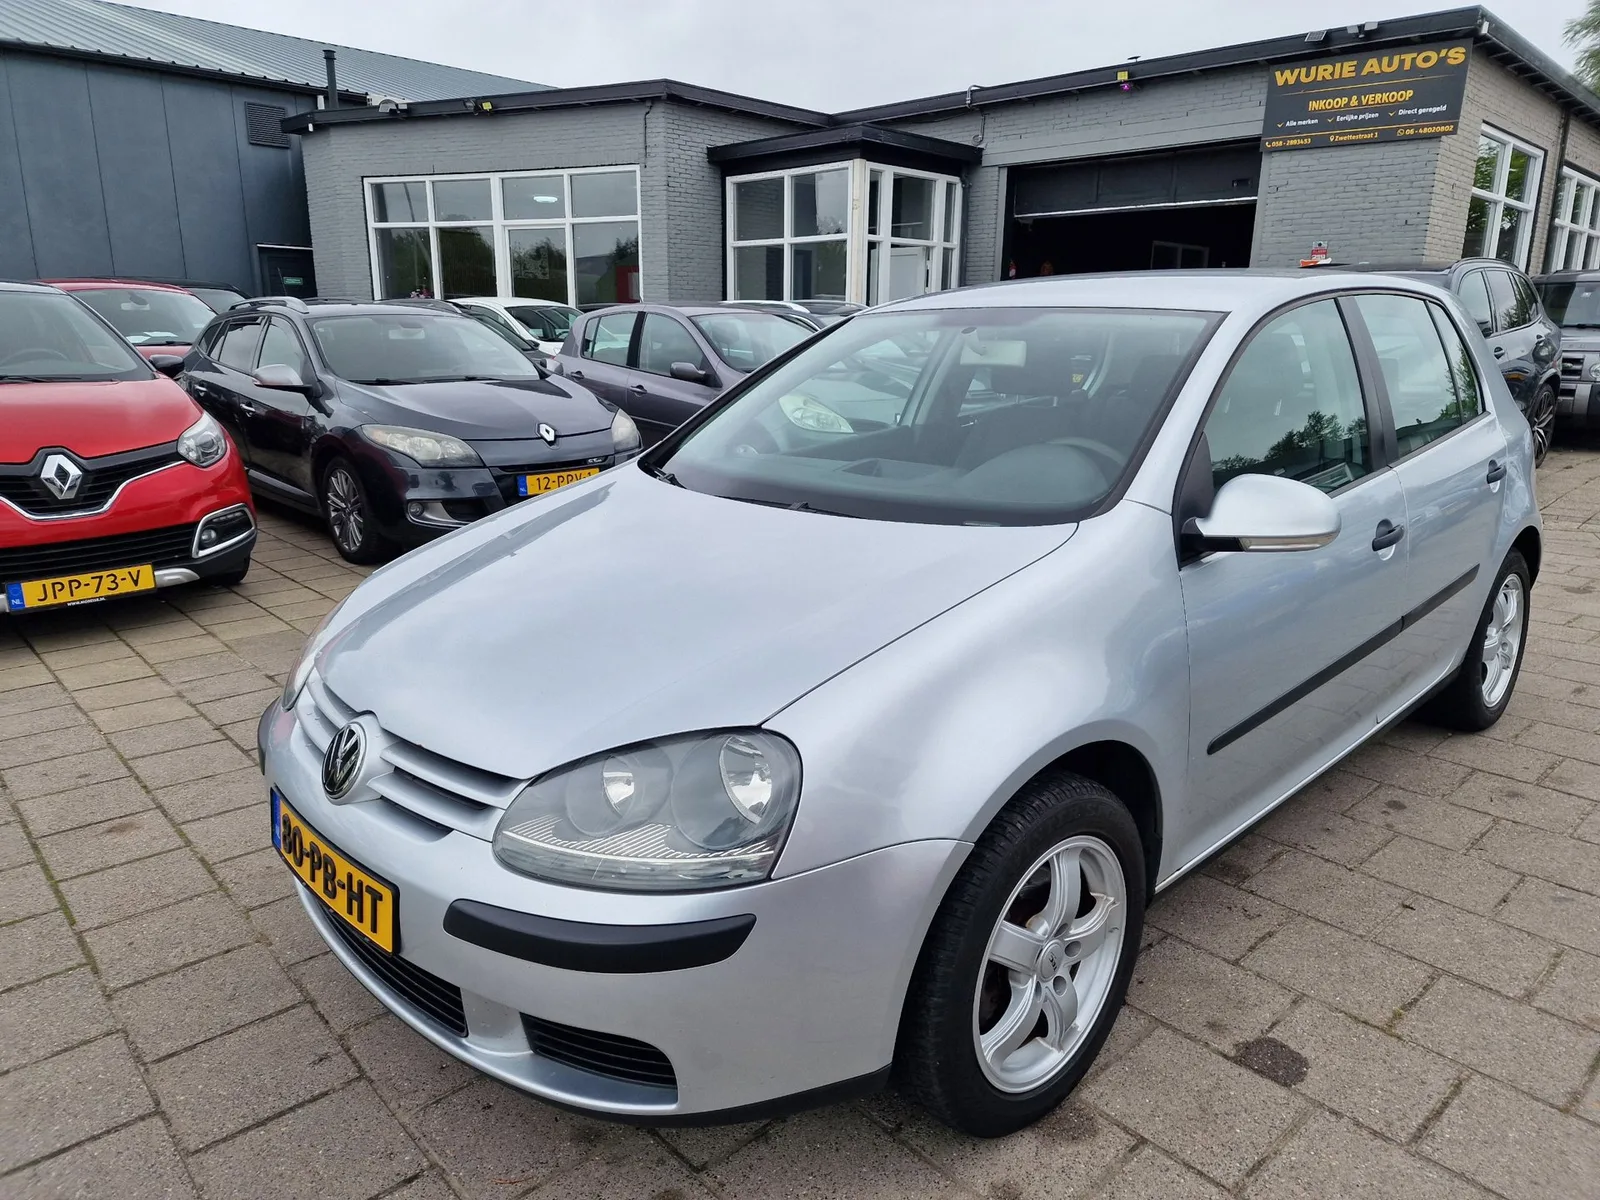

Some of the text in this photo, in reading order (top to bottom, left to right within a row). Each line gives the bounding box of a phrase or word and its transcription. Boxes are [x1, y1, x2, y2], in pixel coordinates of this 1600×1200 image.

[1275, 46, 1466, 86] WURIE AUTO'S
[1308, 89, 1414, 111] INKOOP & VERKOOP
[1398, 104, 1448, 116] Direct geregeld
[1297, 118, 1319, 126] merken
[1358, 112, 1380, 121] prijzen
[37, 569, 141, 601] JPP-73-V
[282, 813, 383, 934] 80-PB-HT
